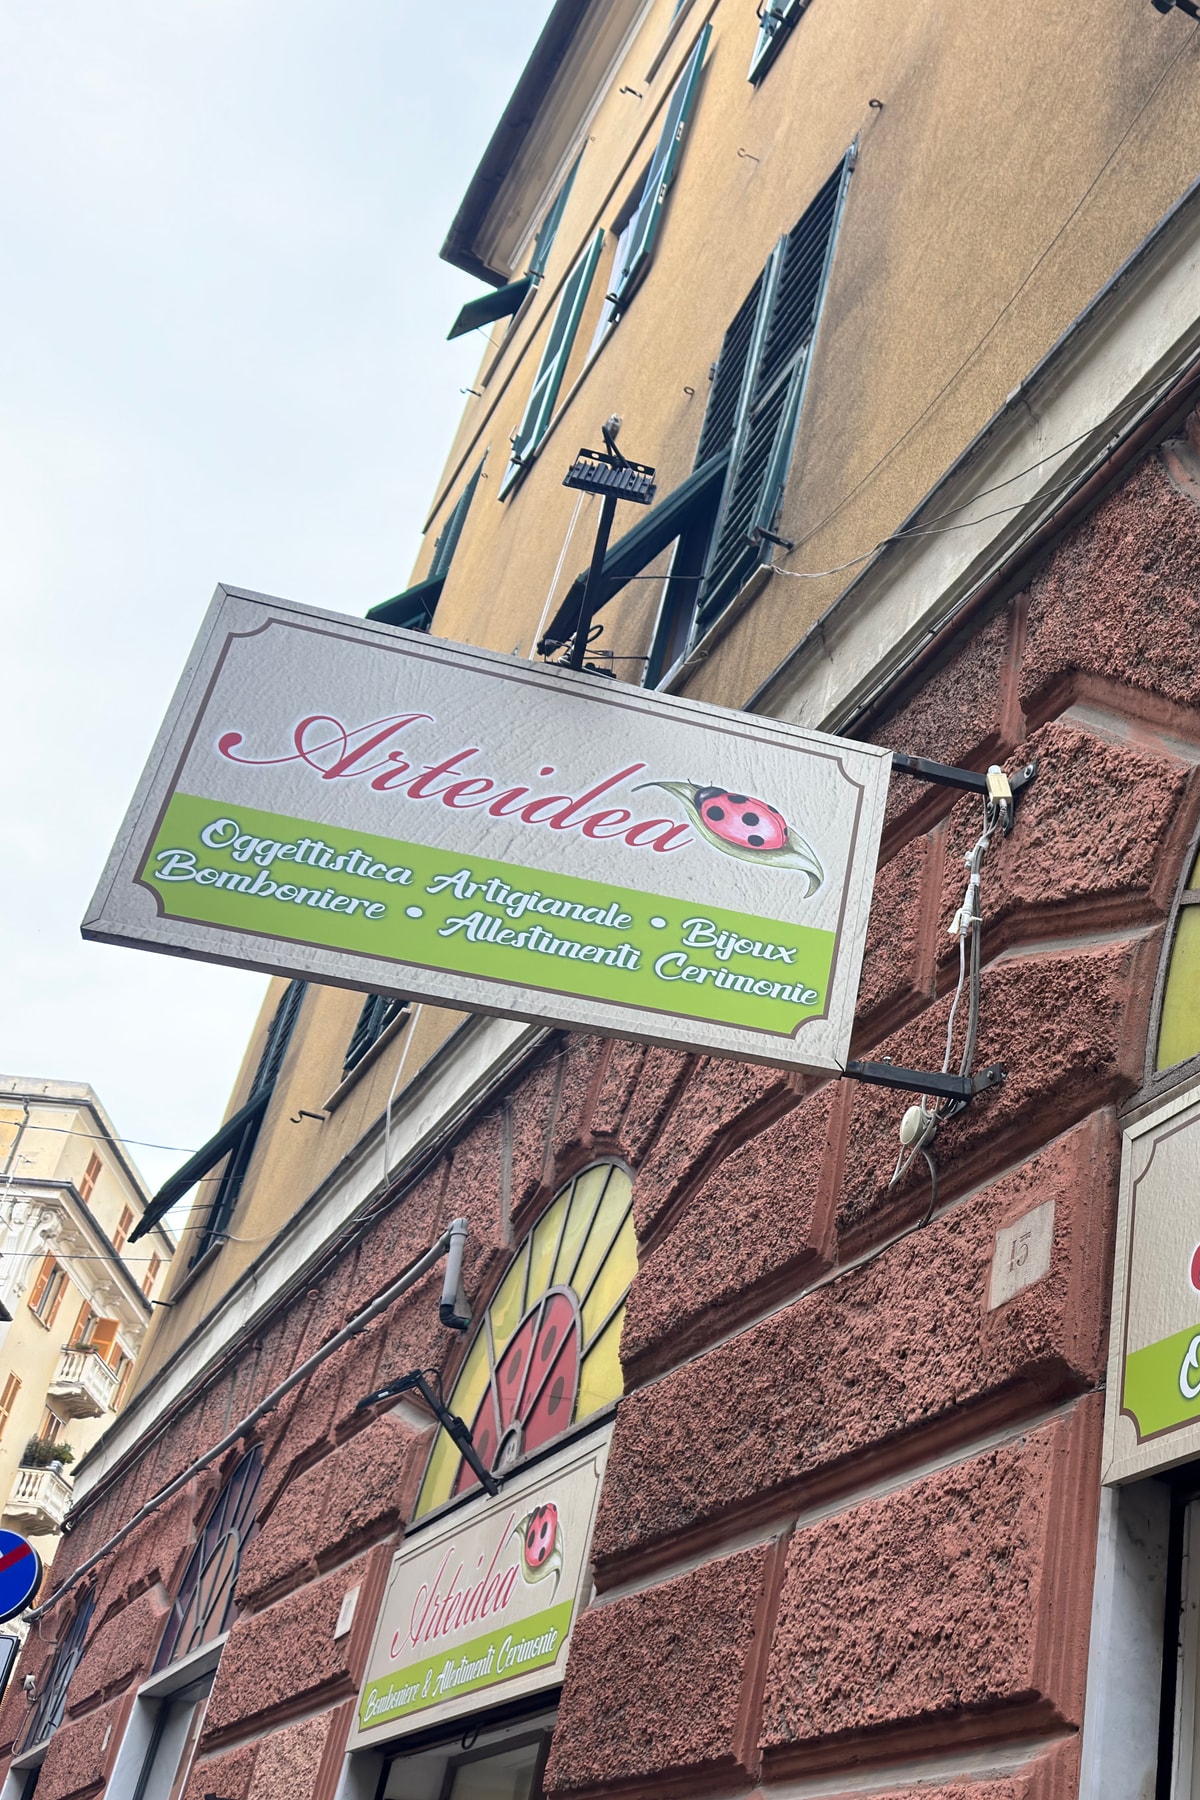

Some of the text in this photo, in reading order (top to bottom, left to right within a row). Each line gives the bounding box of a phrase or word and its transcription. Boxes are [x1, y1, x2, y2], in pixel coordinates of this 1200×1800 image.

[218, 714, 694, 852] Arteidea
[155, 849, 820, 1007] Bomboniere Allestimenti Cerimonie
[199, 819, 798, 964] Oggettistica Artigianale Bijoux
[390, 1511, 520, 1659] Arteidea
[363, 1626, 559, 1722] Bomboniere & Allestimenti Cerimonie
